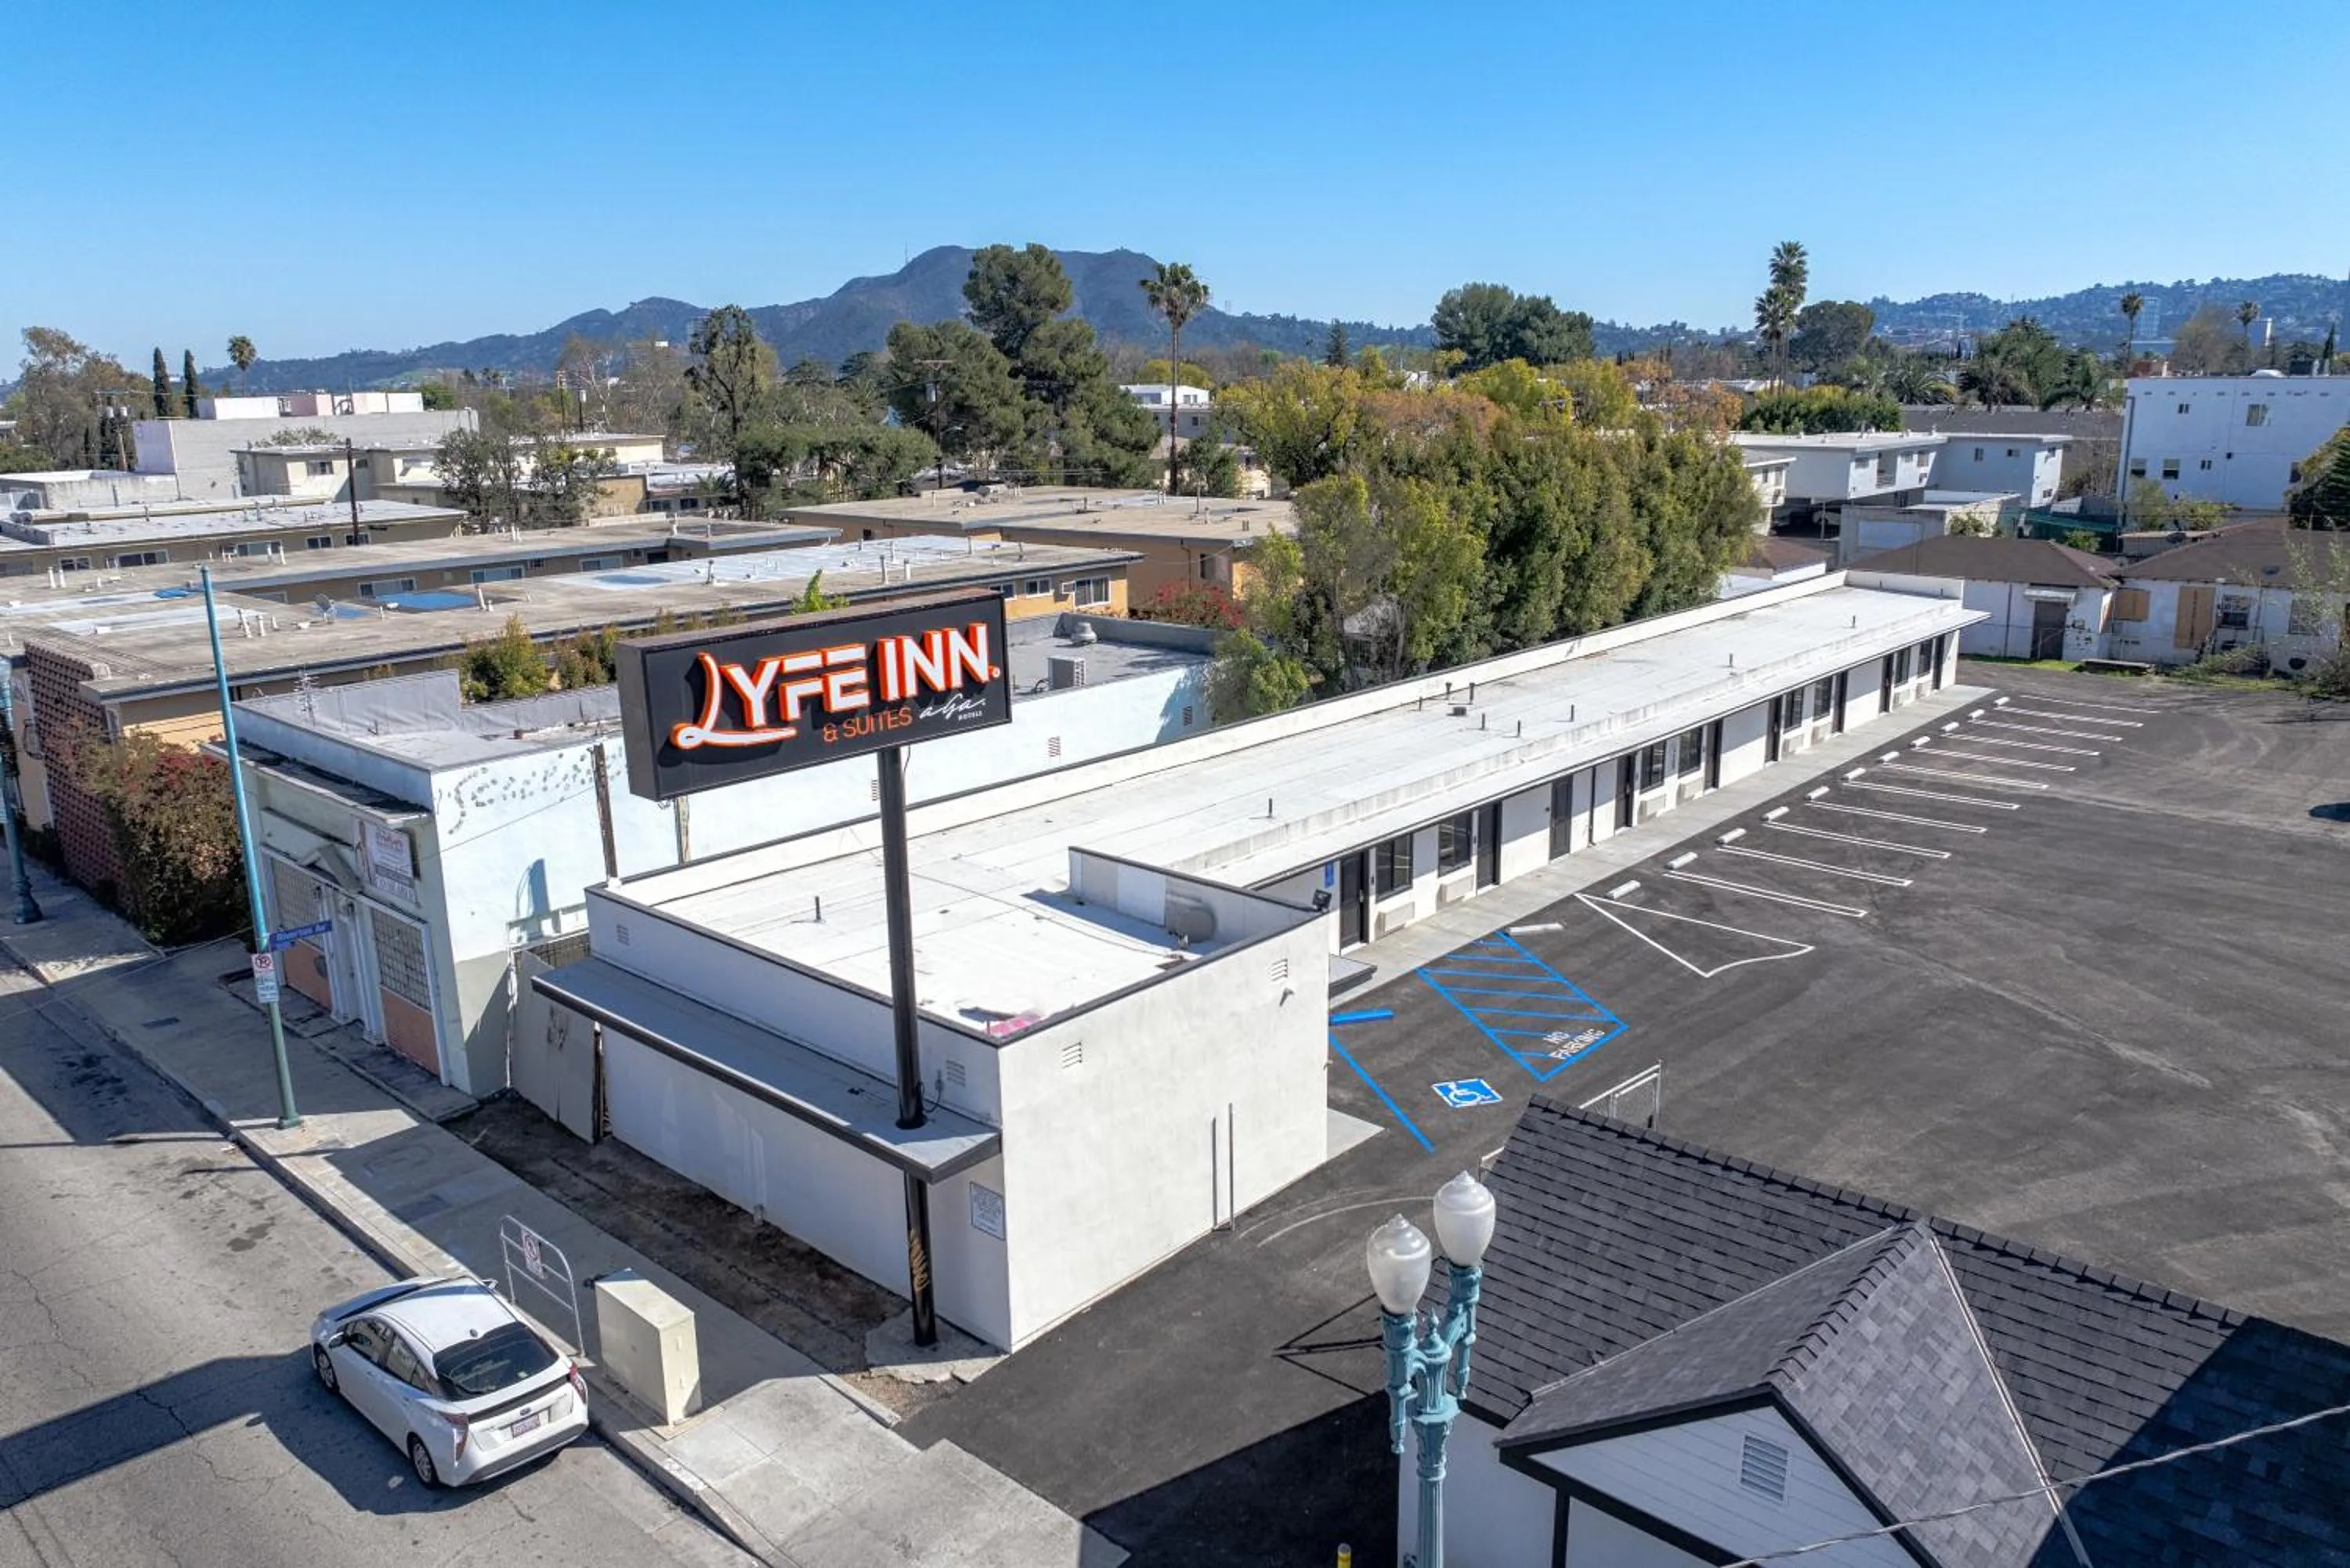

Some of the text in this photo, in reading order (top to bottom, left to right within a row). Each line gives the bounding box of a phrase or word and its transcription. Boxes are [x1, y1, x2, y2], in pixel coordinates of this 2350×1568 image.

[670, 642, 871, 750] LYFE
[823, 706, 913, 742] & SUITES
[1542, 1031, 1571, 1045] NO
[1548, 1028, 1605, 1060] PARKING
